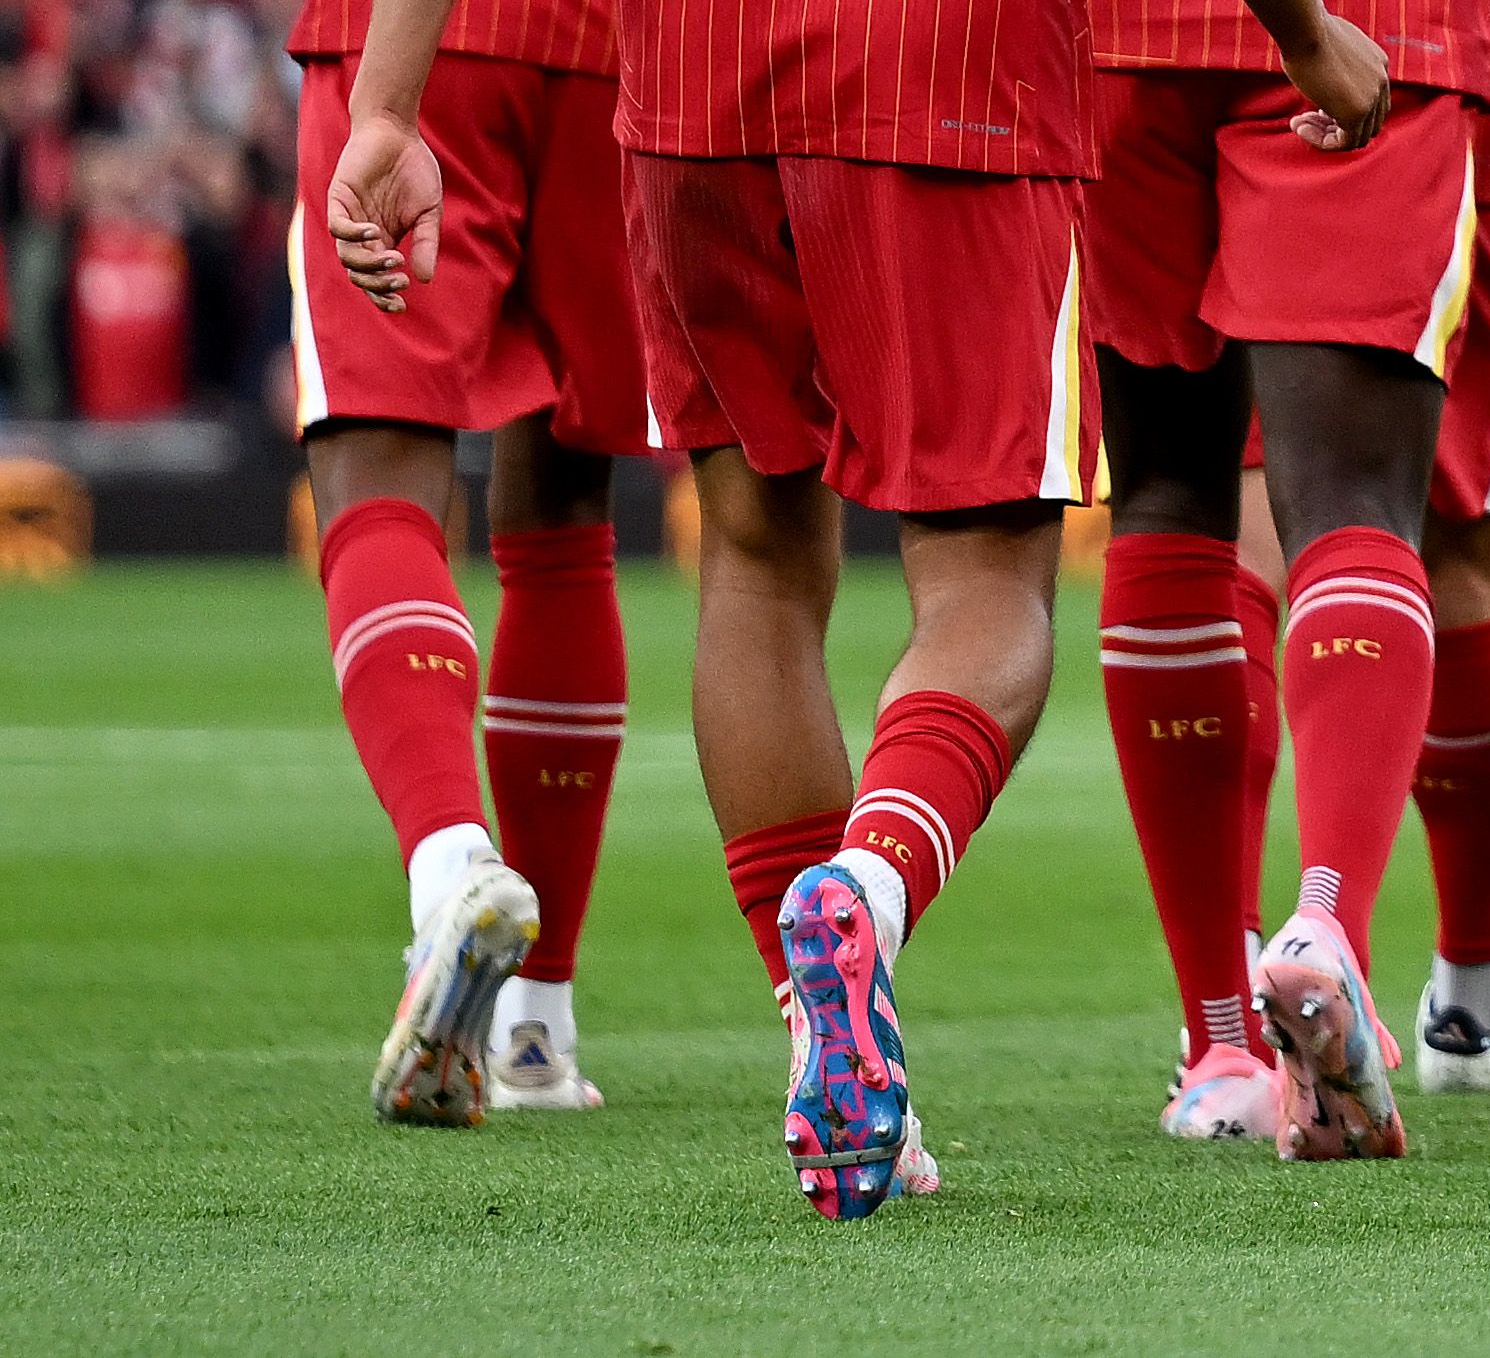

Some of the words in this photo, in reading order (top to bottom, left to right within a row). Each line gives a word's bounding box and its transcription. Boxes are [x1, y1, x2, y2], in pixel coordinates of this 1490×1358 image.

[1311, 637, 1382, 660] LFC
[409, 654, 467, 680] LFC
[1149, 716, 1222, 740] LFC
[539, 769, 594, 789] LFC
[866, 830, 913, 864] LFC
